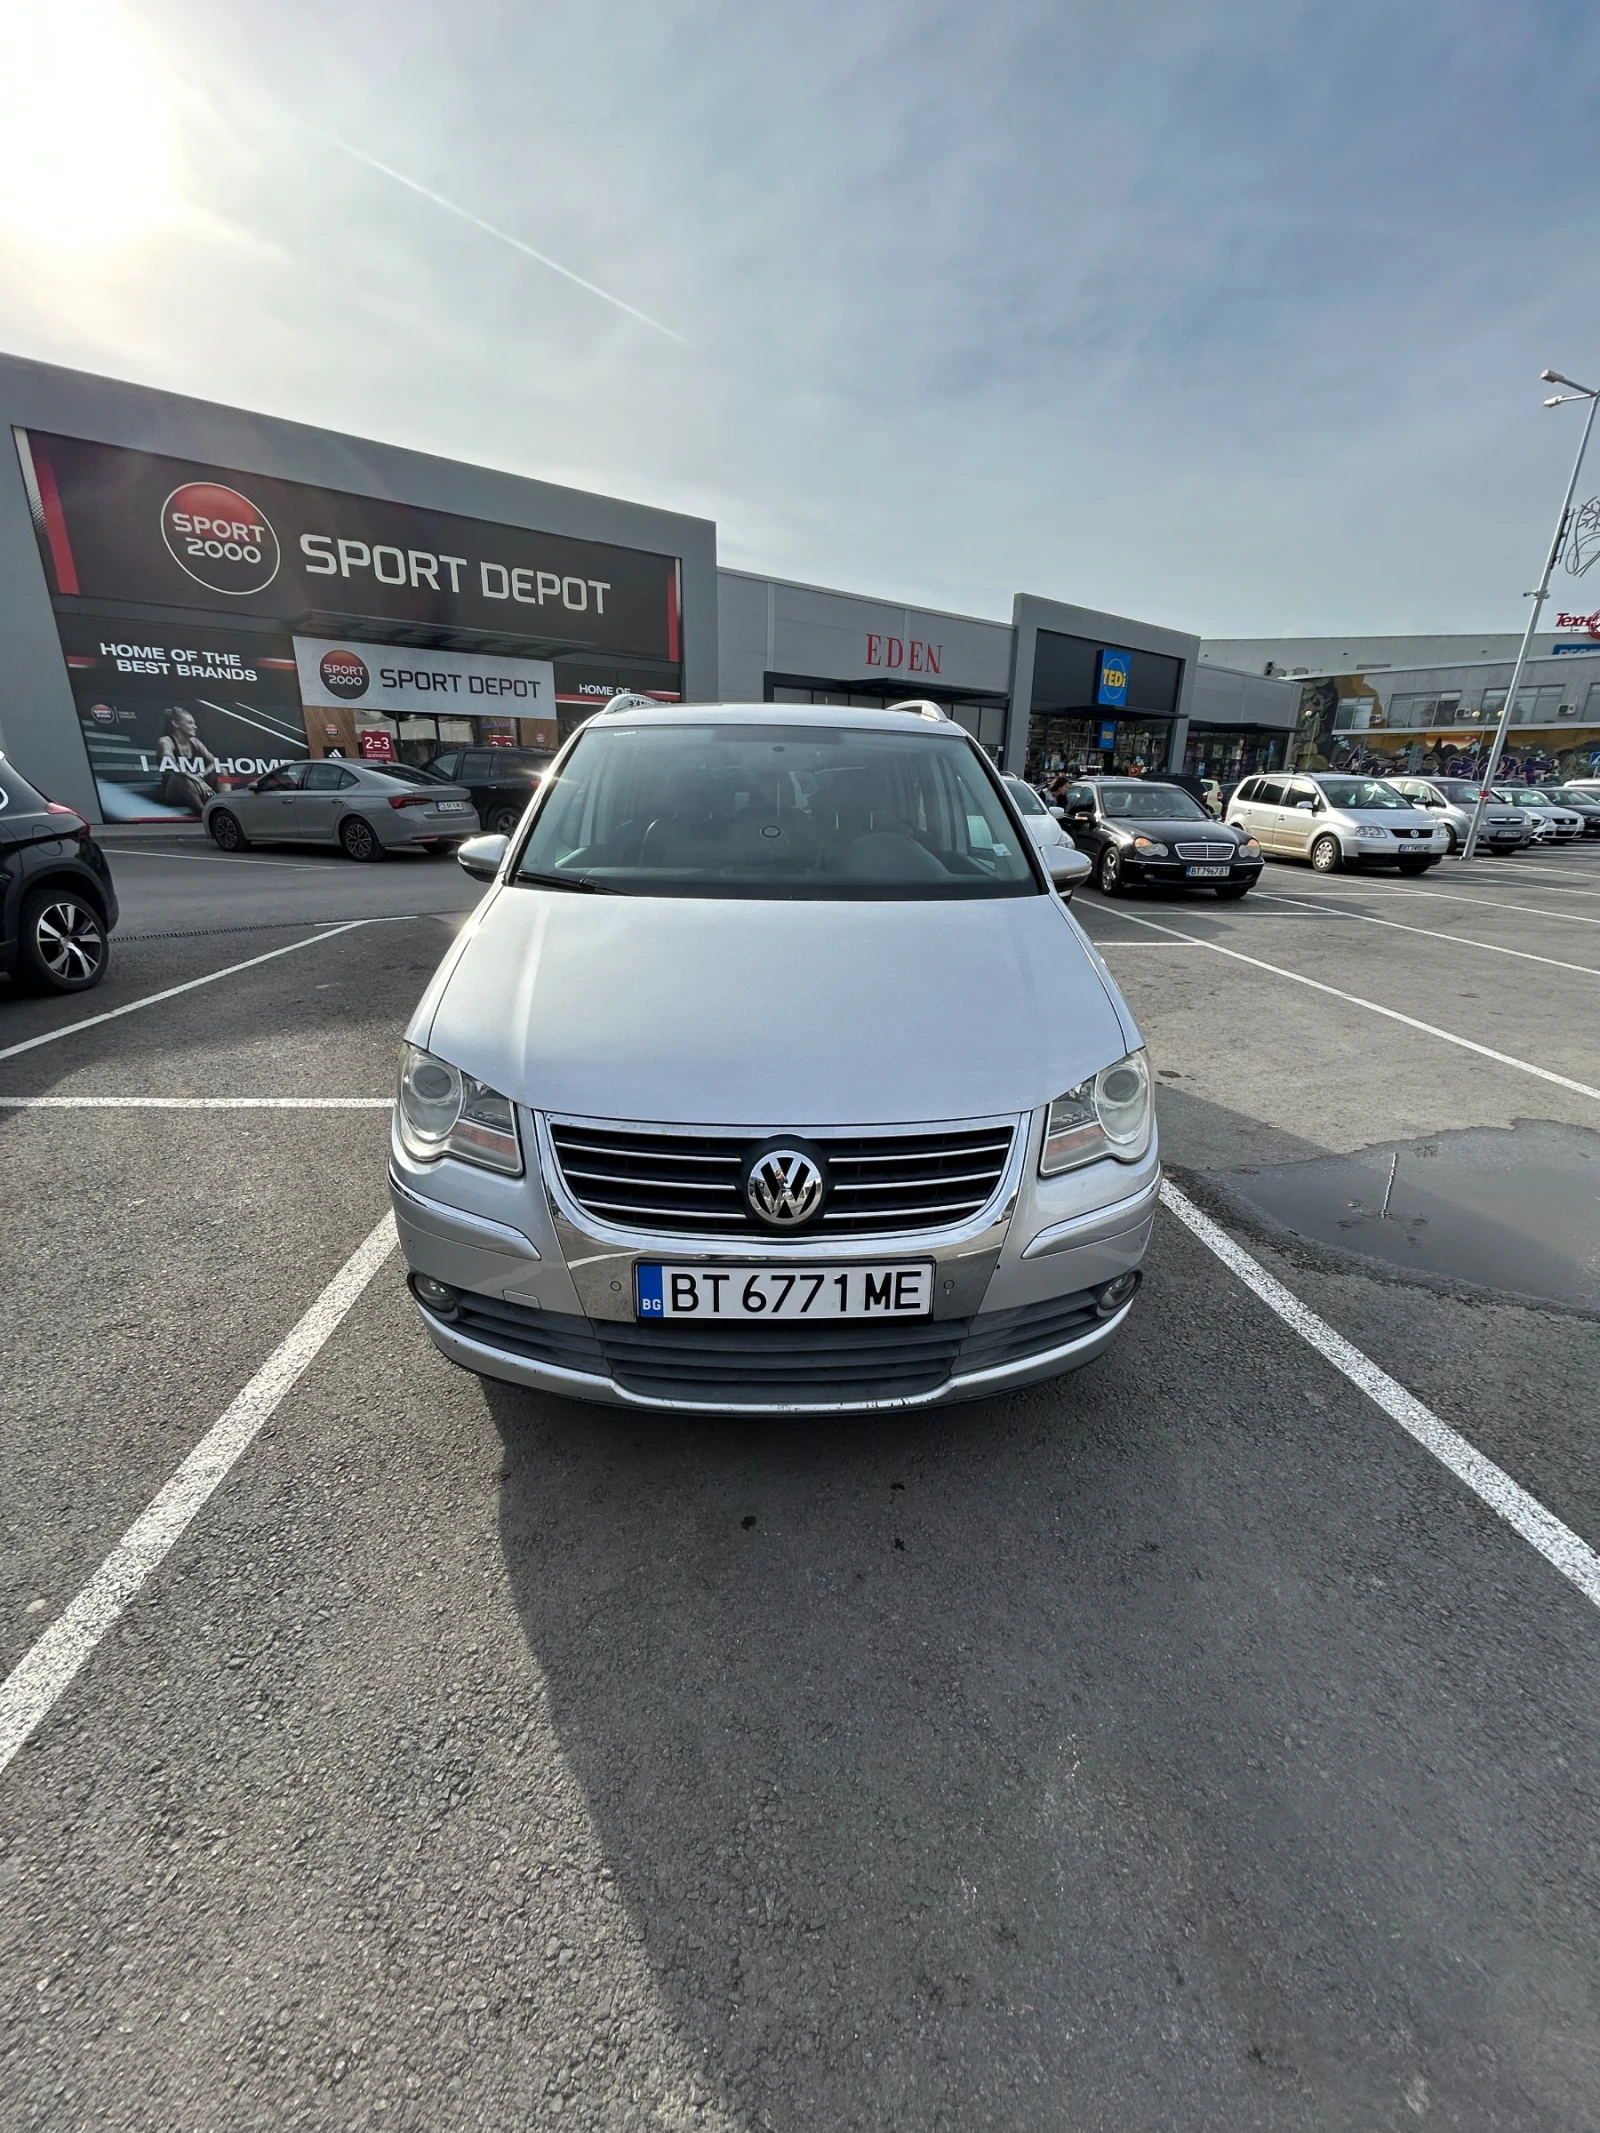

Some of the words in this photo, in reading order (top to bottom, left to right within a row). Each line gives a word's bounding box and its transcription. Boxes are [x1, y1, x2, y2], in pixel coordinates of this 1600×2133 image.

[172, 512, 265, 543] SPORT
[185, 537, 262, 564] 2000
[300, 533, 467, 593] SPORT
[480, 561, 611, 614] DEPOT
[100, 642, 166, 660] HOME
[170, 649, 198, 662] OF
[202, 651, 242, 666] THE
[865, 633, 943, 674] EDEN
[116, 659, 171, 675] BEST
[176, 664, 258, 682] BRANDS
[323, 663, 365, 676] SPORT
[328, 674, 363, 686] 2000
[1103, 668, 1127, 688] TEDi
[379, 668, 462, 693] SPORT
[468, 675, 541, 699] DEPOT
[579, 684, 614, 696] HOME
[616, 687, 631, 695] OF
[364, 736, 390, 750] 2=3
[140, 755, 150, 772] I
[159, 755, 206, 774] AM
[671, 1273, 730, 1312] BT
[742, 1273, 848, 1313] 6771
[864, 1270, 922, 1311] ME
[642, 1298, 662, 1311] BG
